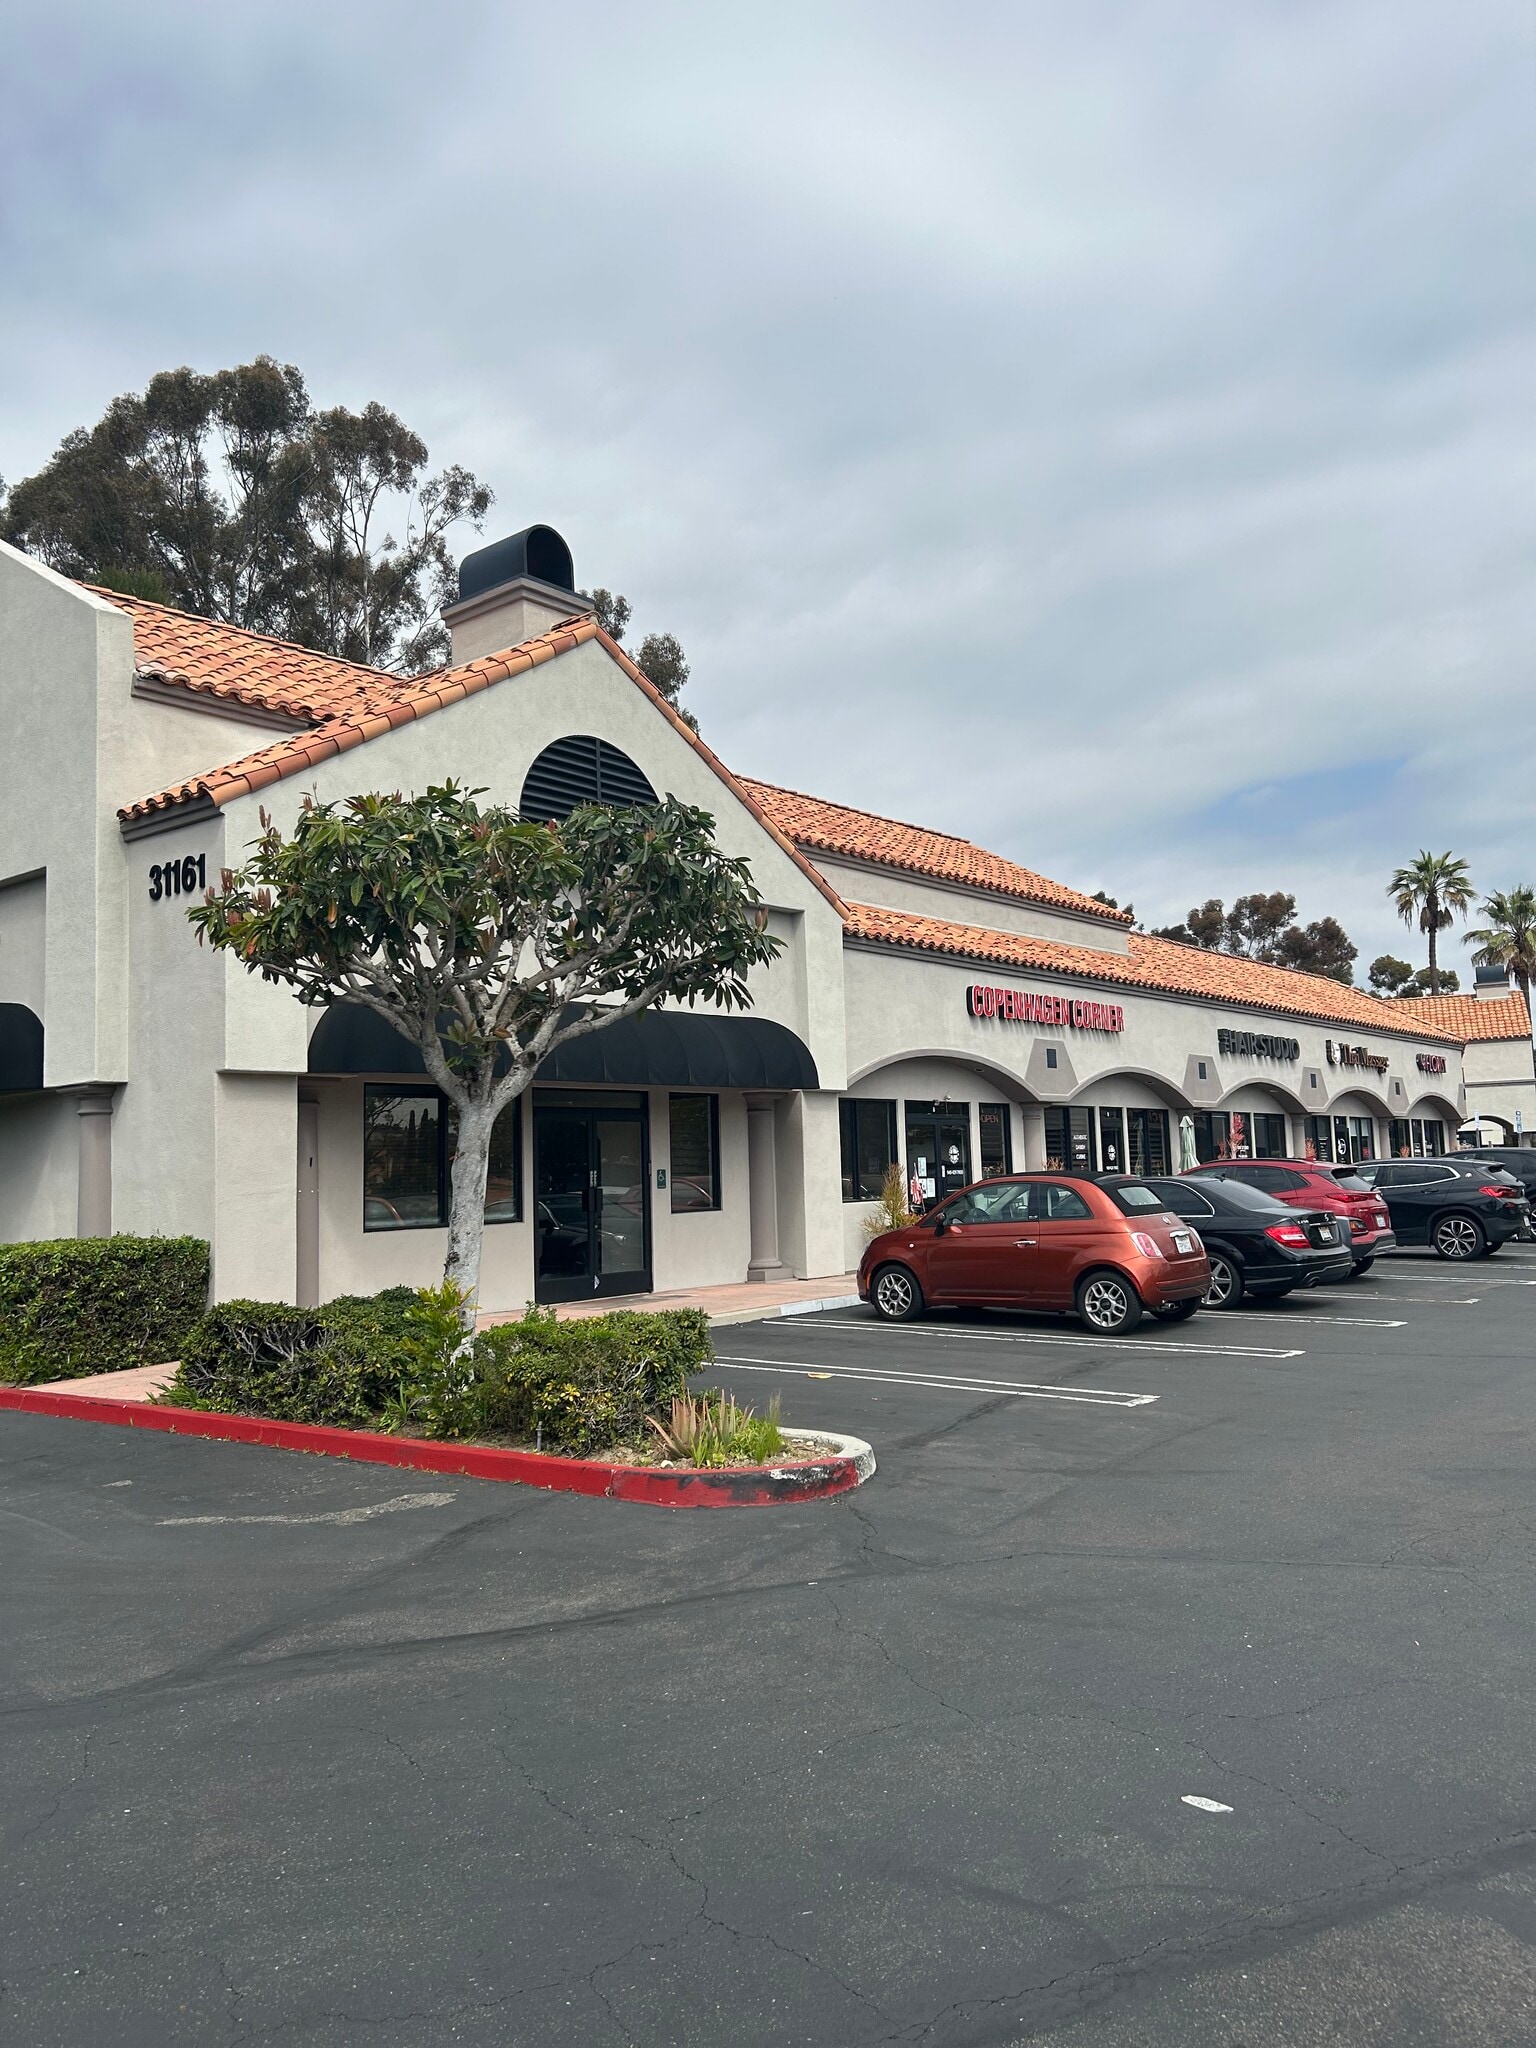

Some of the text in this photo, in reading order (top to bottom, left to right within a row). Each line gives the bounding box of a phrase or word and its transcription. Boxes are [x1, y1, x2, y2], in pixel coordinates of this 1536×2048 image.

[148, 852, 206, 901] 31161
[968, 985, 1125, 1032] COPENHAGEN CORNER
[1228, 1030, 1258, 1056] HAIR
[1258, 1034, 1300, 1060] STUDIO
[981, 1114, 999, 1123] OPEN
